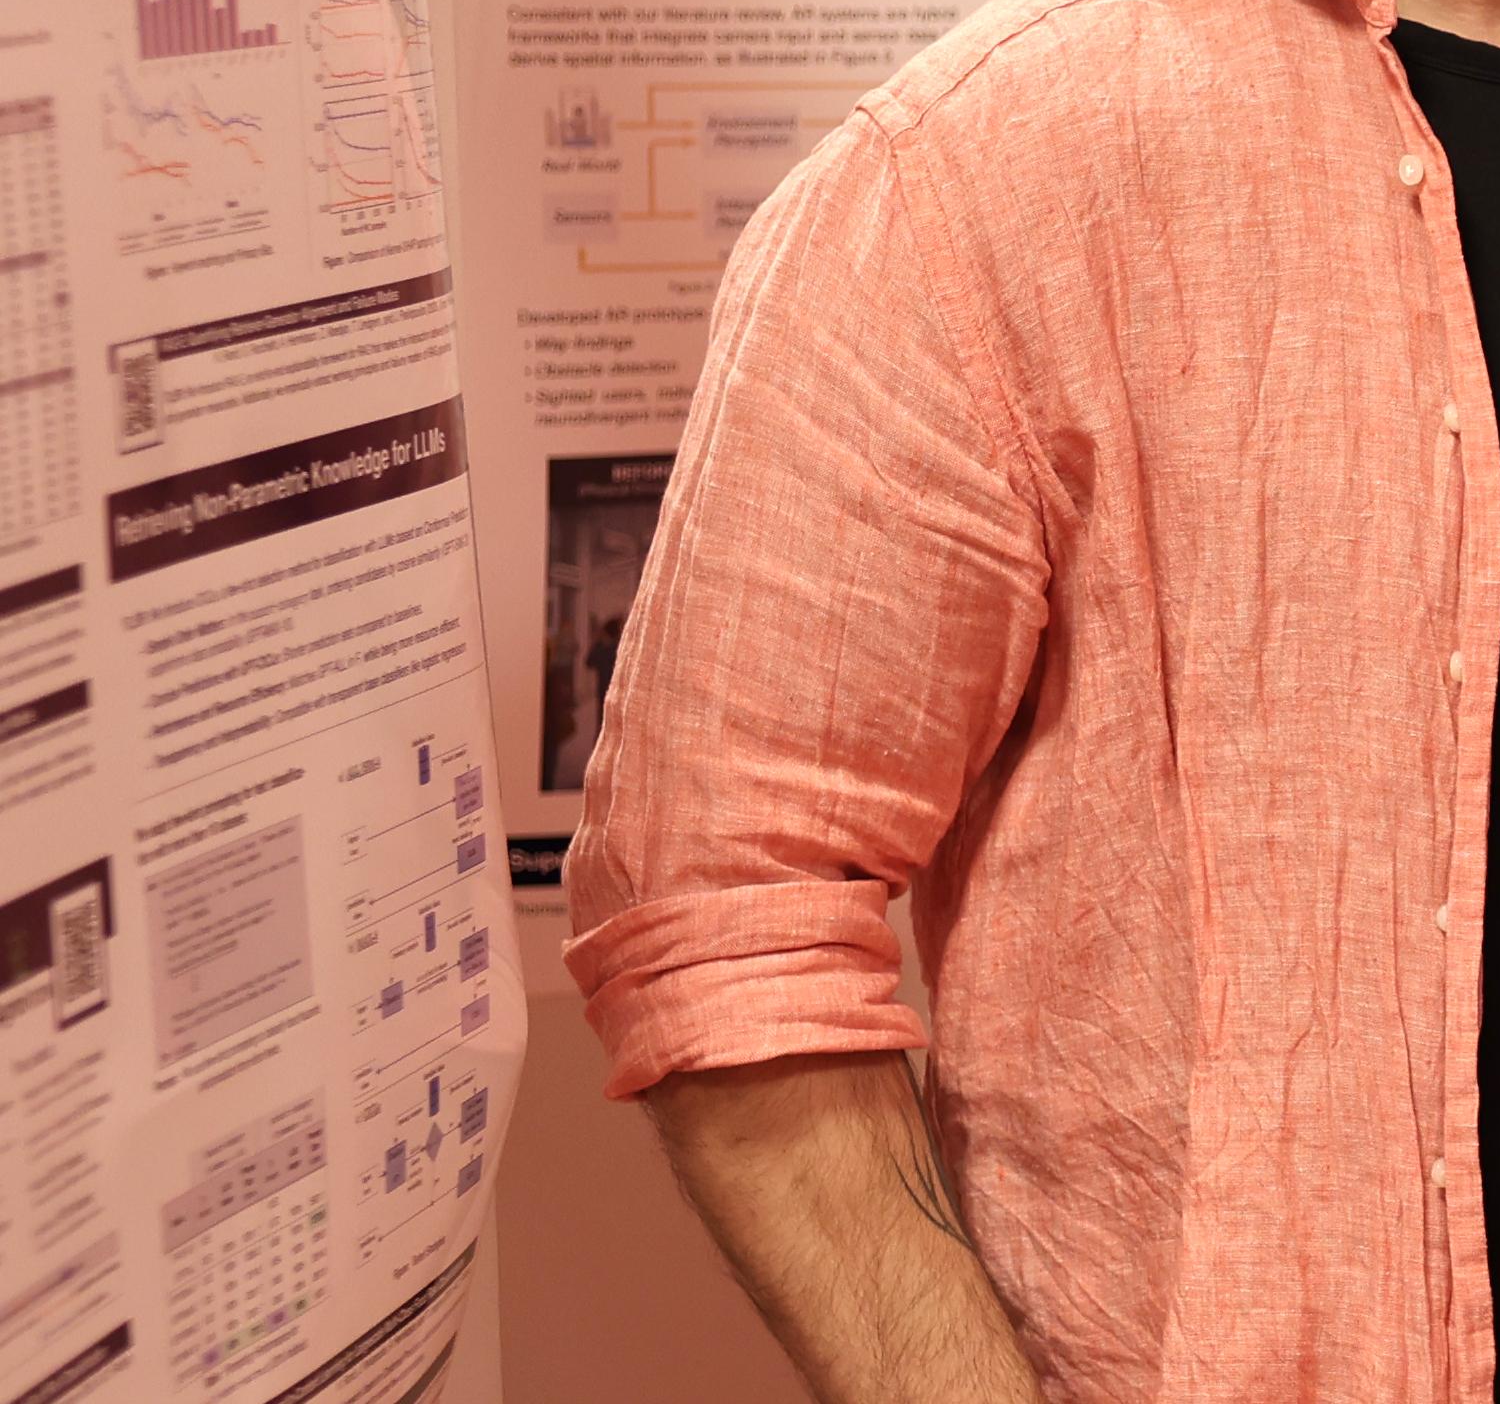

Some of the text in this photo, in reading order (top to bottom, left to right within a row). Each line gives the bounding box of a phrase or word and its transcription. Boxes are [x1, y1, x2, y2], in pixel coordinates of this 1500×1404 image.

[310, 446, 390, 489] Knowledge
[392, 440, 410, 467] for
[413, 428, 446, 462] LLMs
